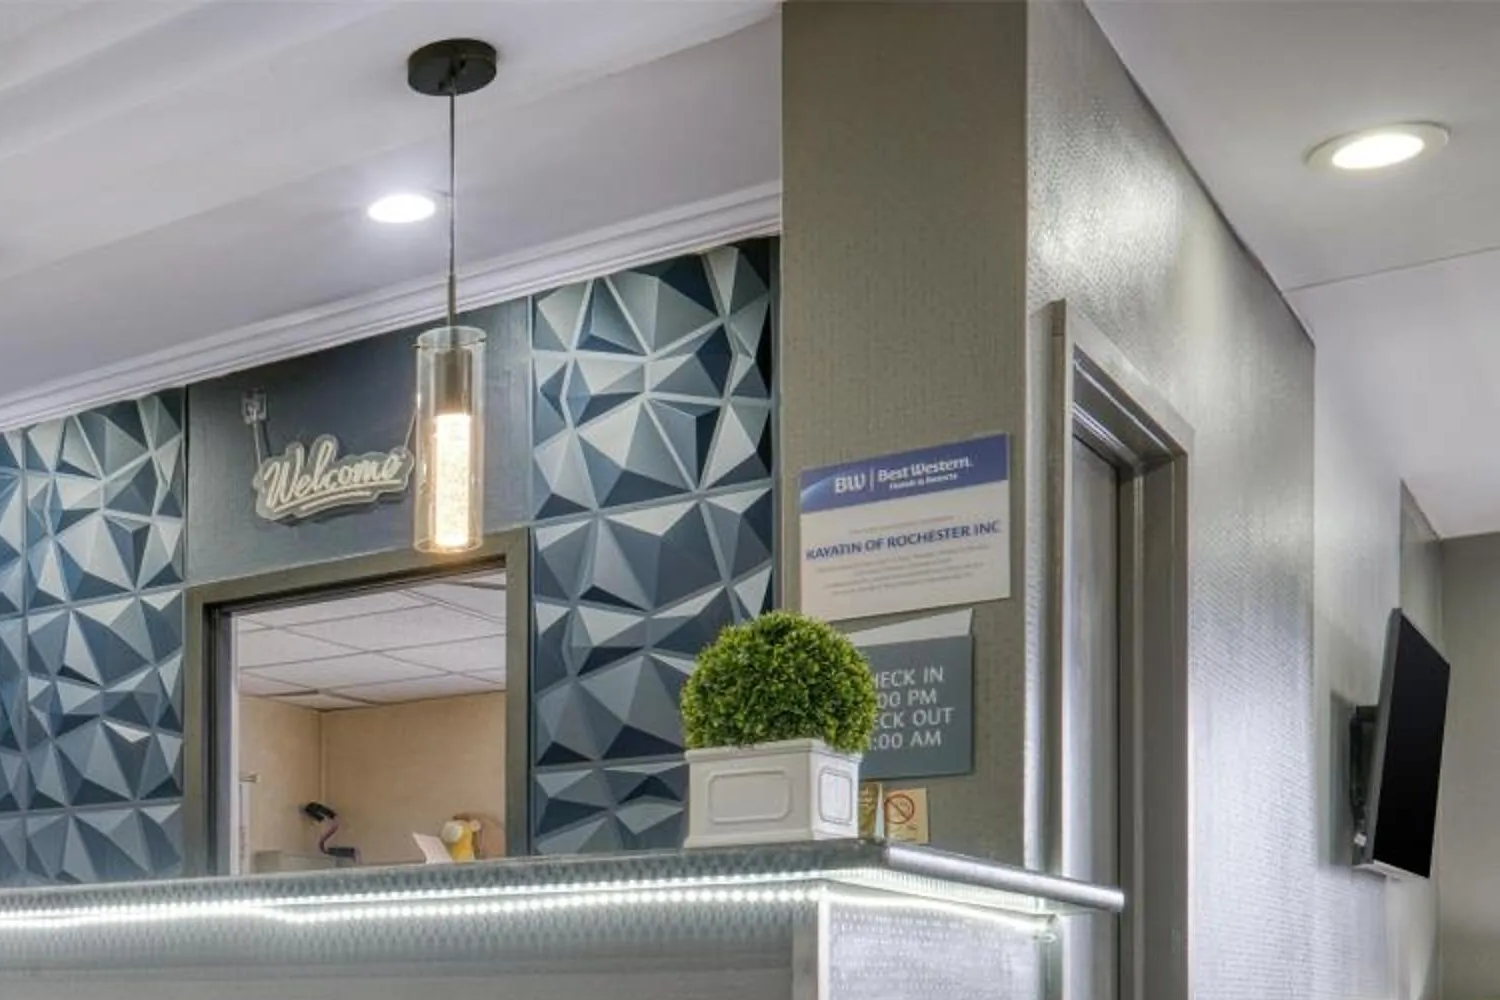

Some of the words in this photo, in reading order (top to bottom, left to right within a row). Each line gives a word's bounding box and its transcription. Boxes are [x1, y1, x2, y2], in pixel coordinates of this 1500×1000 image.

[264, 440, 403, 508] Welcome
[834, 473, 866, 494] BW
[877, 464, 909, 483] Best
[865, 536, 887, 553] OF
[887, 524, 972, 549] ROCHESTER
[973, 519, 1001, 536] INC
[922, 665, 944, 684] IN
[907, 687, 937, 706] PM
[912, 706, 955, 727] OUT
[909, 729, 942, 749] AM
